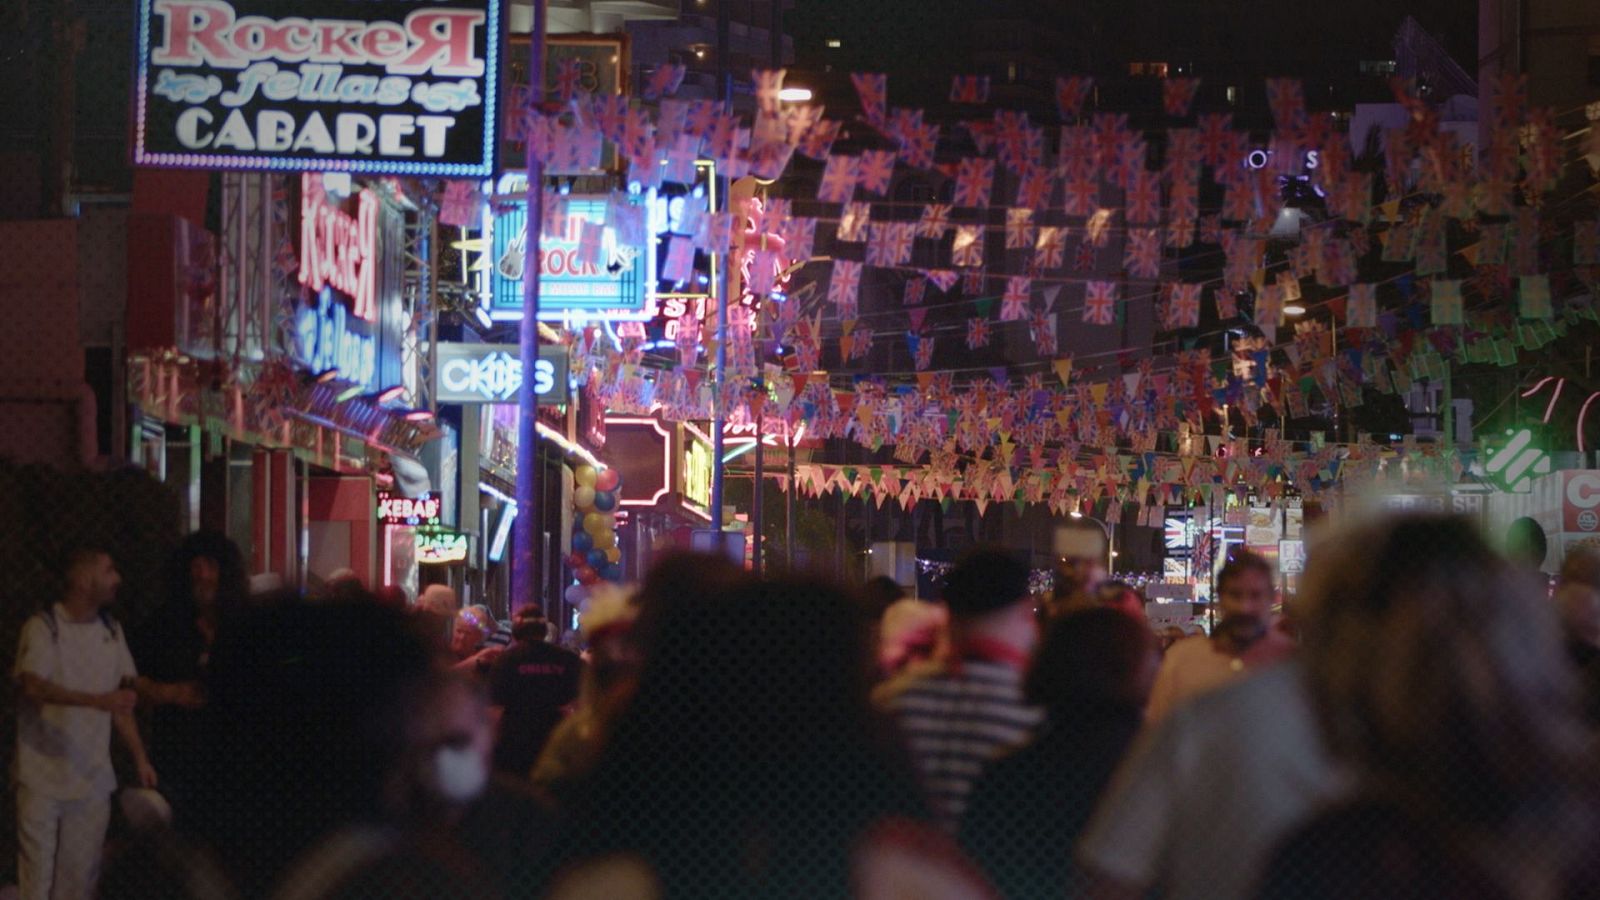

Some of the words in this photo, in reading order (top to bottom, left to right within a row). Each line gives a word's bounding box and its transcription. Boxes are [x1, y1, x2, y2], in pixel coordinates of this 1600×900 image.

[220, 61, 413, 108] fellas
[175, 107, 456, 157] CABARET
[380, 499, 437, 518] KEBAB
